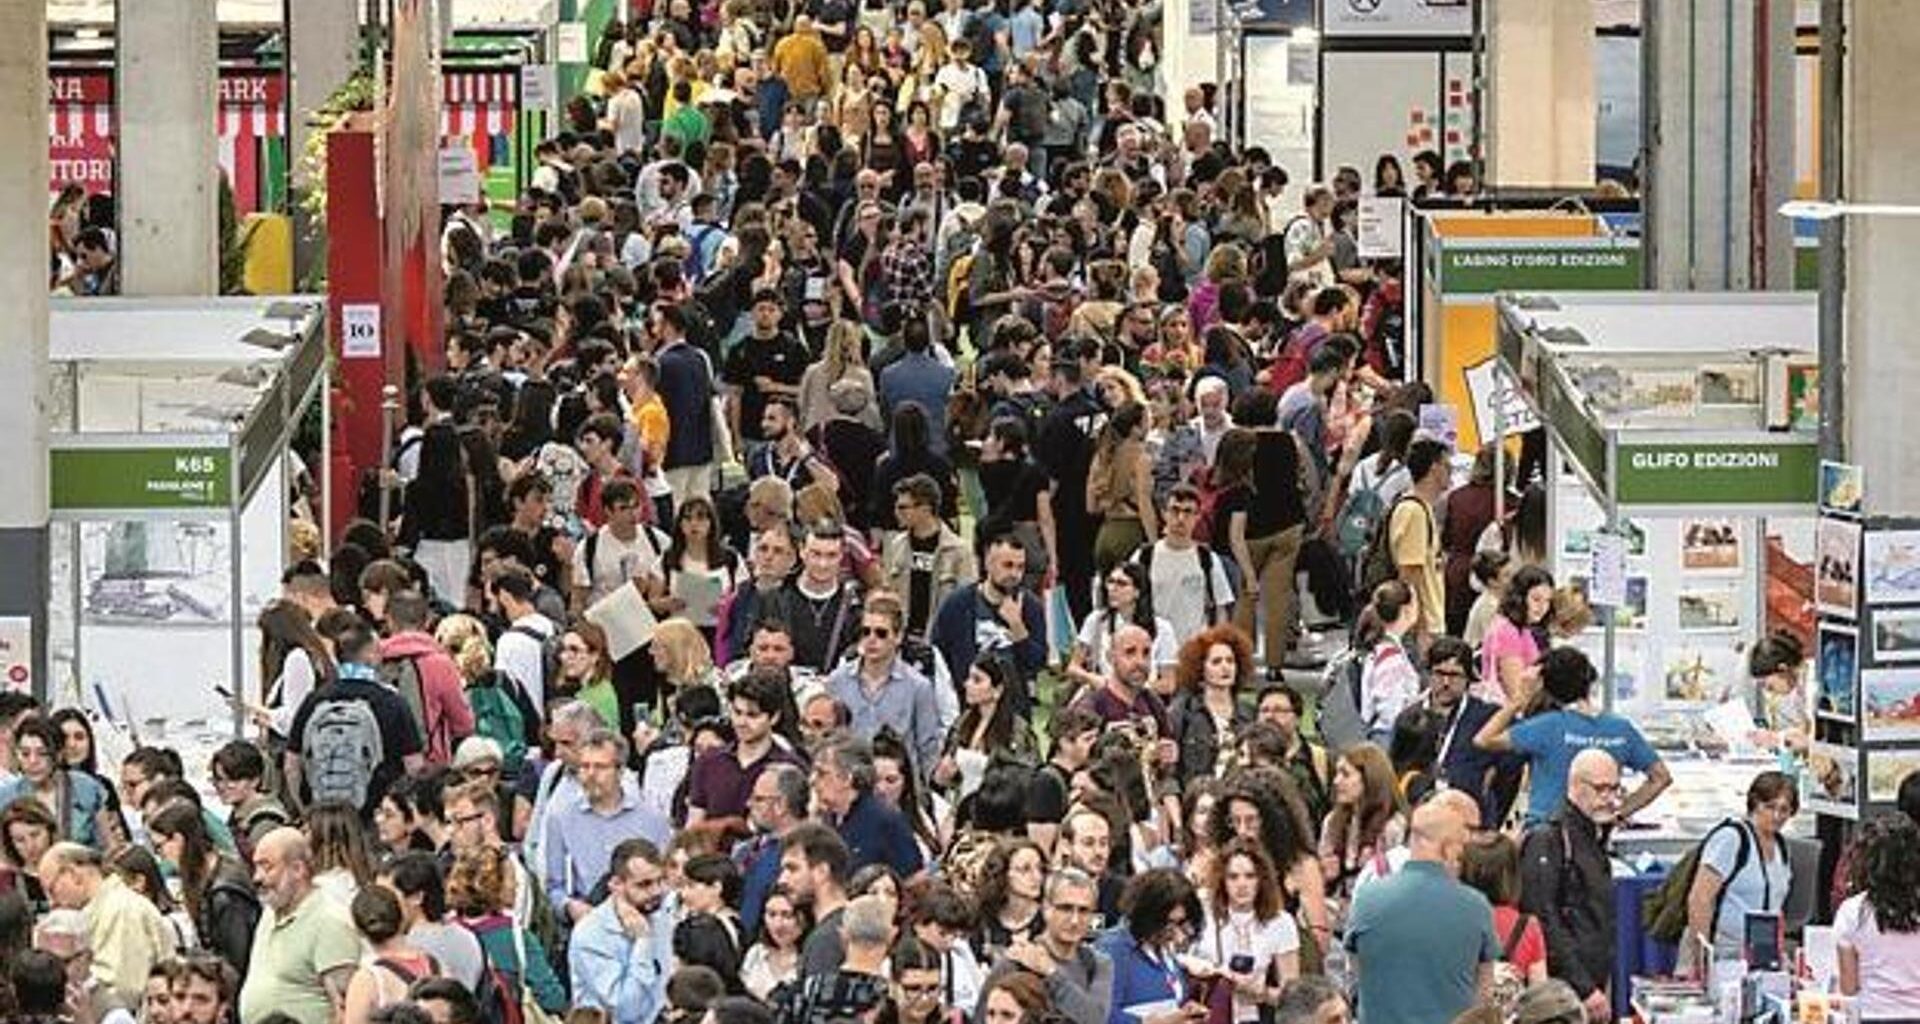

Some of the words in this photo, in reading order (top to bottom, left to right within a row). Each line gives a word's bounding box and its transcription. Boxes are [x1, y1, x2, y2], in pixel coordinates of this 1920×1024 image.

[1561, 254, 1626, 267] EDIZIONI
[175, 456, 214, 472] K65
[1632, 452, 1689, 468] GLIFO
[1693, 452, 1778, 467] EDIZIONI
